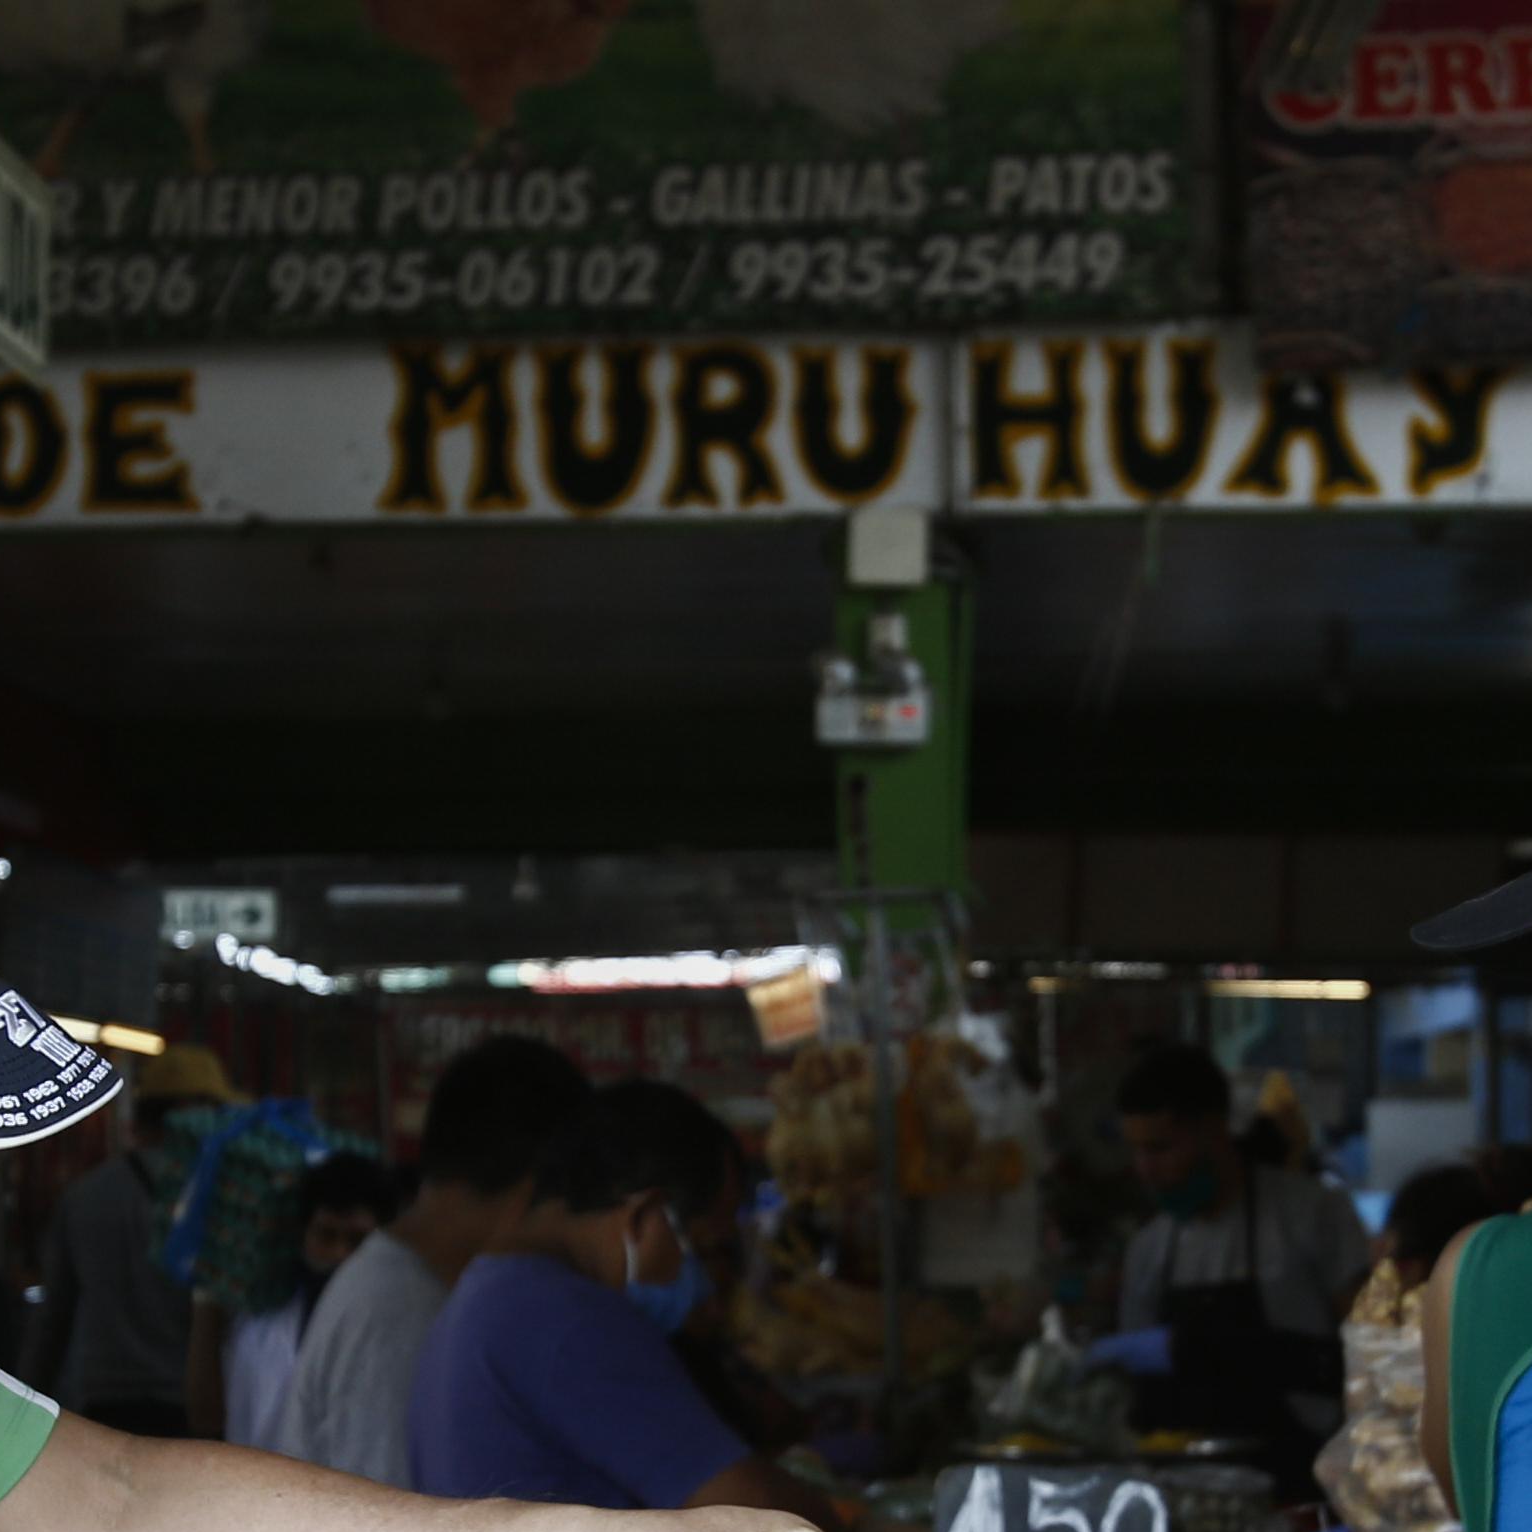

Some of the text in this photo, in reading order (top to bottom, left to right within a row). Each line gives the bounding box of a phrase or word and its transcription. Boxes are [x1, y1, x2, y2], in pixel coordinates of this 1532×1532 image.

[101, 178, 139, 237] Y
[149, 174, 361, 238] MENOR
[378, 168, 594, 236] POLLOS
[652, 161, 932, 229] GALLINAS
[988, 152, 1174, 218] PATOS
[268, 246, 660, 316] 9935-06102
[730, 231, 1124, 303] 9935-25449
[22, 1079, 60, 1103] 1962
[29, 1095, 67, 1121] 1937
